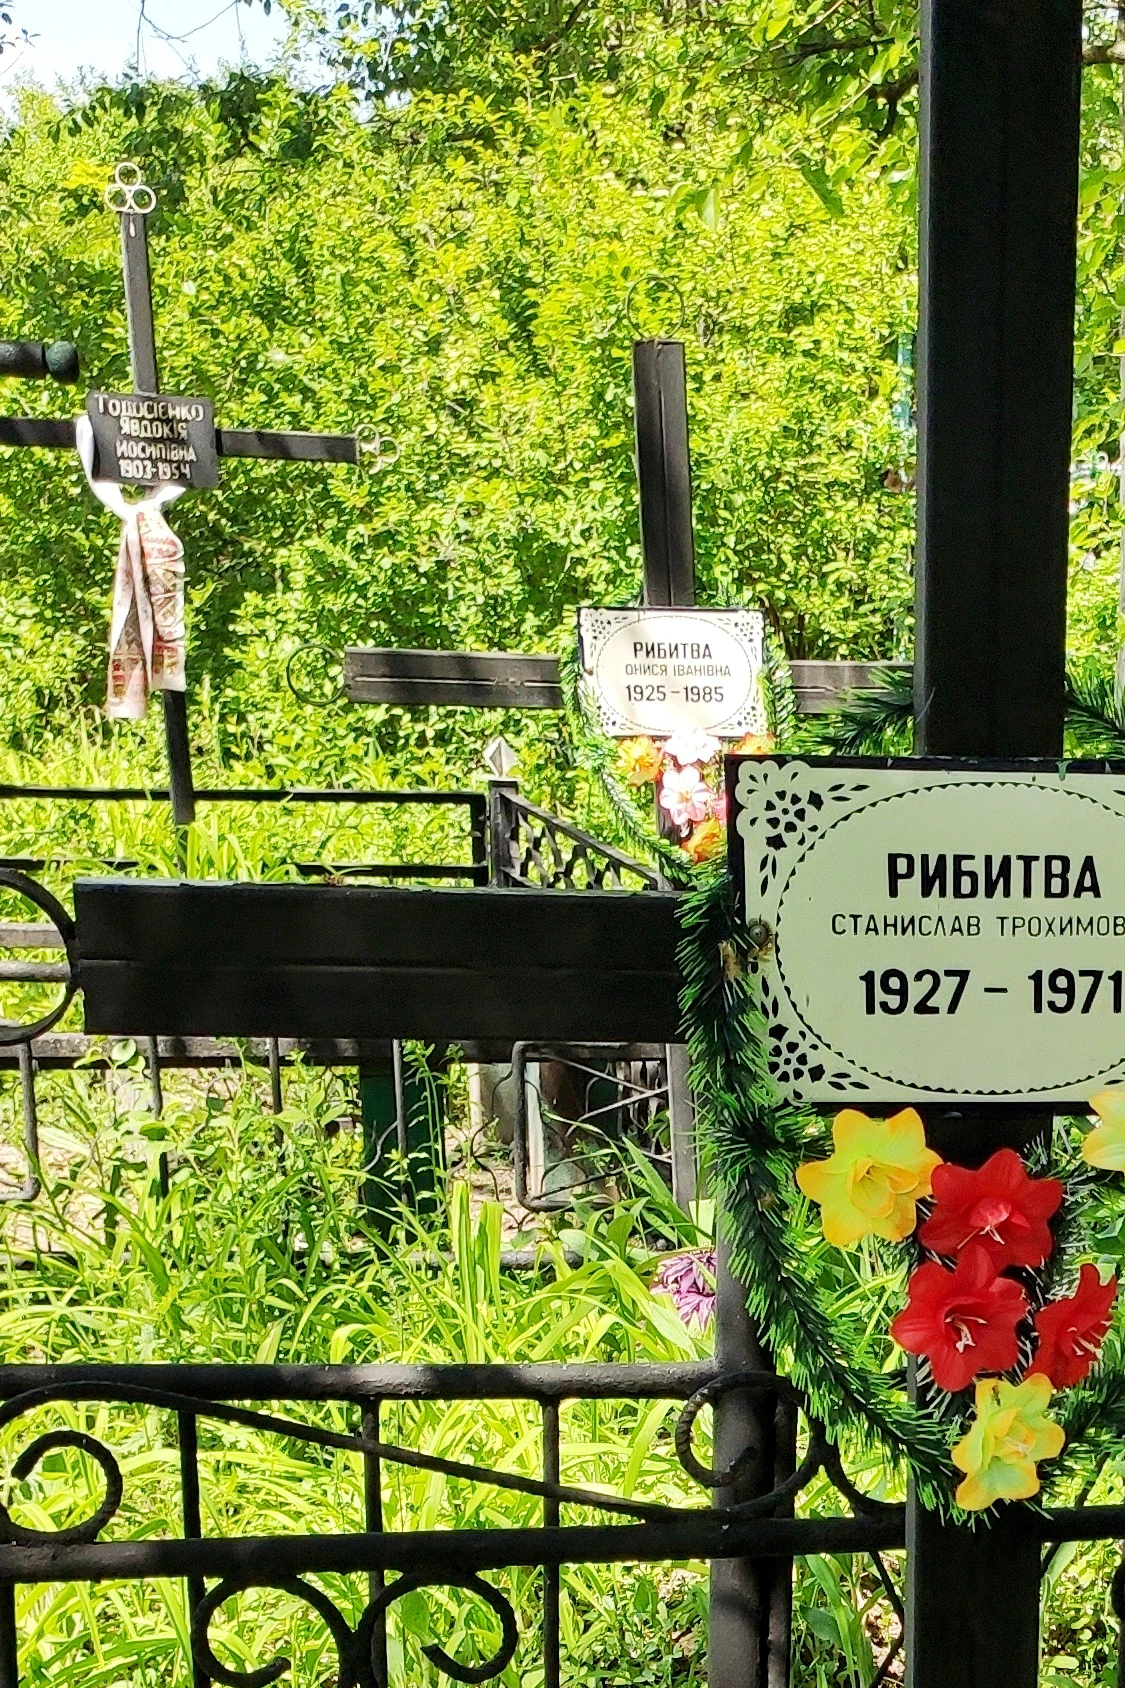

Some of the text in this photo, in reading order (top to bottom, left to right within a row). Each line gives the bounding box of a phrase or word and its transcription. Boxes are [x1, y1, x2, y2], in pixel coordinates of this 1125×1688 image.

[633, 641, 713, 660] РИБИТВА
[625, 663, 731, 677] ОНИСЯ ІВАНІВНА
[887, 852, 1101, 899] РИБИТВА
[831, 913, 981, 937] СТАНИСЛАВ
